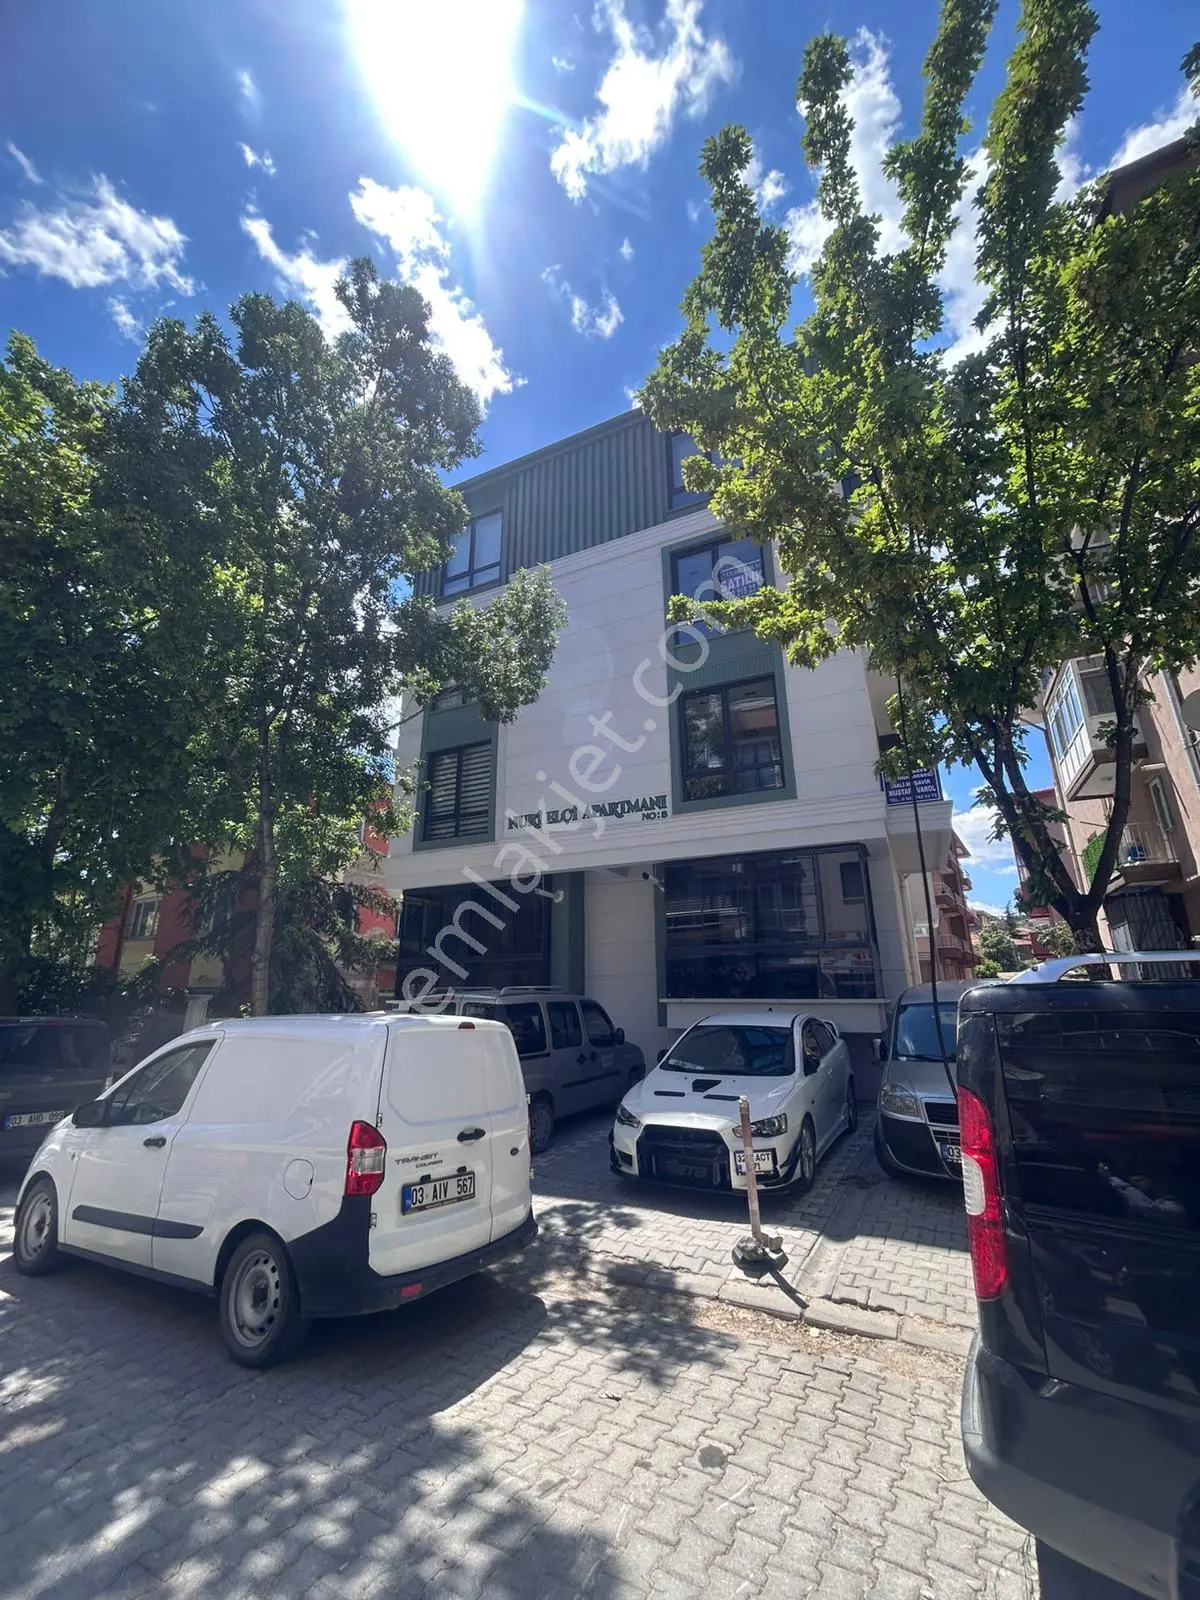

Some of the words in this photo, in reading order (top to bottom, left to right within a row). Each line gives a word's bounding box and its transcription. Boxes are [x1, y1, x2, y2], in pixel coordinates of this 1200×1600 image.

[888, 787, 914, 797] MUSTAF
[916, 785, 937, 794] VAROL
[755, 1153, 770, 1162] ACT
[948, 1146, 961, 1158] 03
[395, 1152, 439, 1165] TRANSIT
[411, 1187, 424, 1206] 03
[432, 1181, 448, 1202] AIV
[457, 1176, 473, 1195] 567
